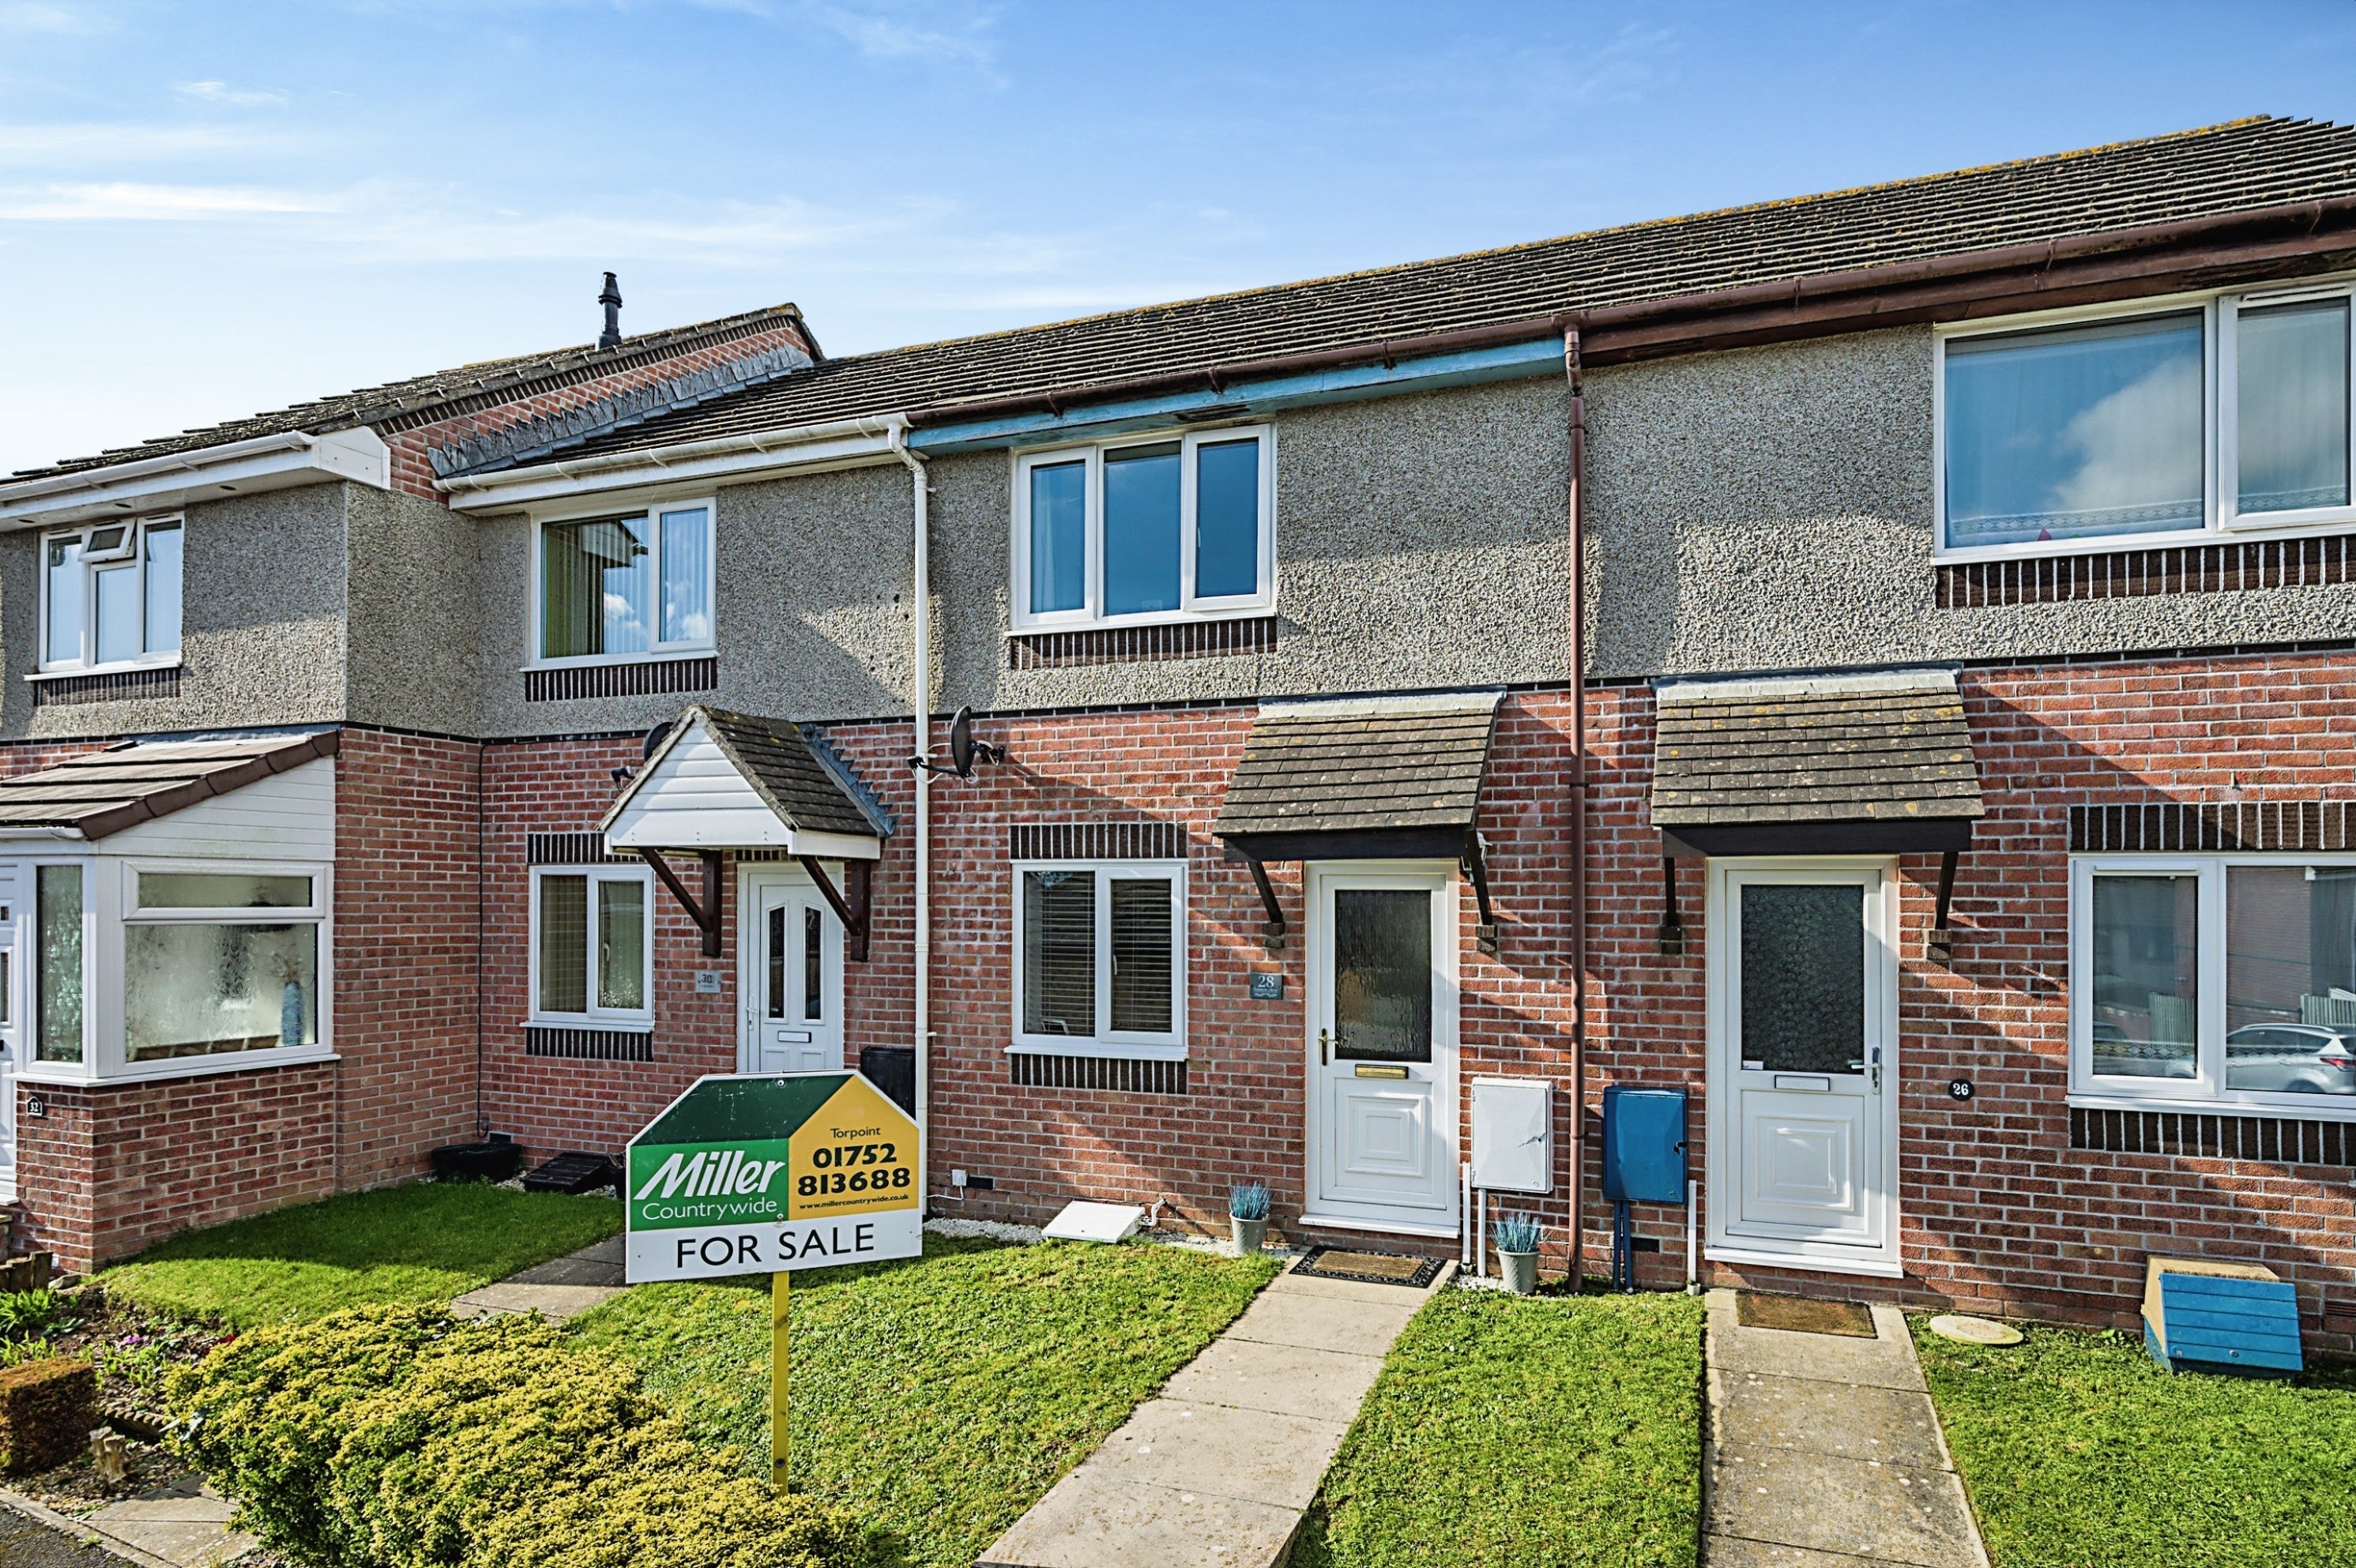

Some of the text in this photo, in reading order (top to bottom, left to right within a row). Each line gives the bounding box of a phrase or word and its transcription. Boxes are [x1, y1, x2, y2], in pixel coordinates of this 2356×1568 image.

[1258, 975, 1274, 987] 28
[1952, 1083, 1969, 1096] 26
[30, 1102, 39, 1112] 32
[830, 1126, 881, 1140] Torpoint
[812, 1143, 897, 1168] 01752
[633, 1150, 786, 1200] Miller
[798, 1168, 910, 1196] 813688
[642, 1197, 777, 1220] Countrywide
[799, 1194, 909, 1209] www.millercountrywide.co.uk
[677, 1224, 875, 1268] FOR SALE
